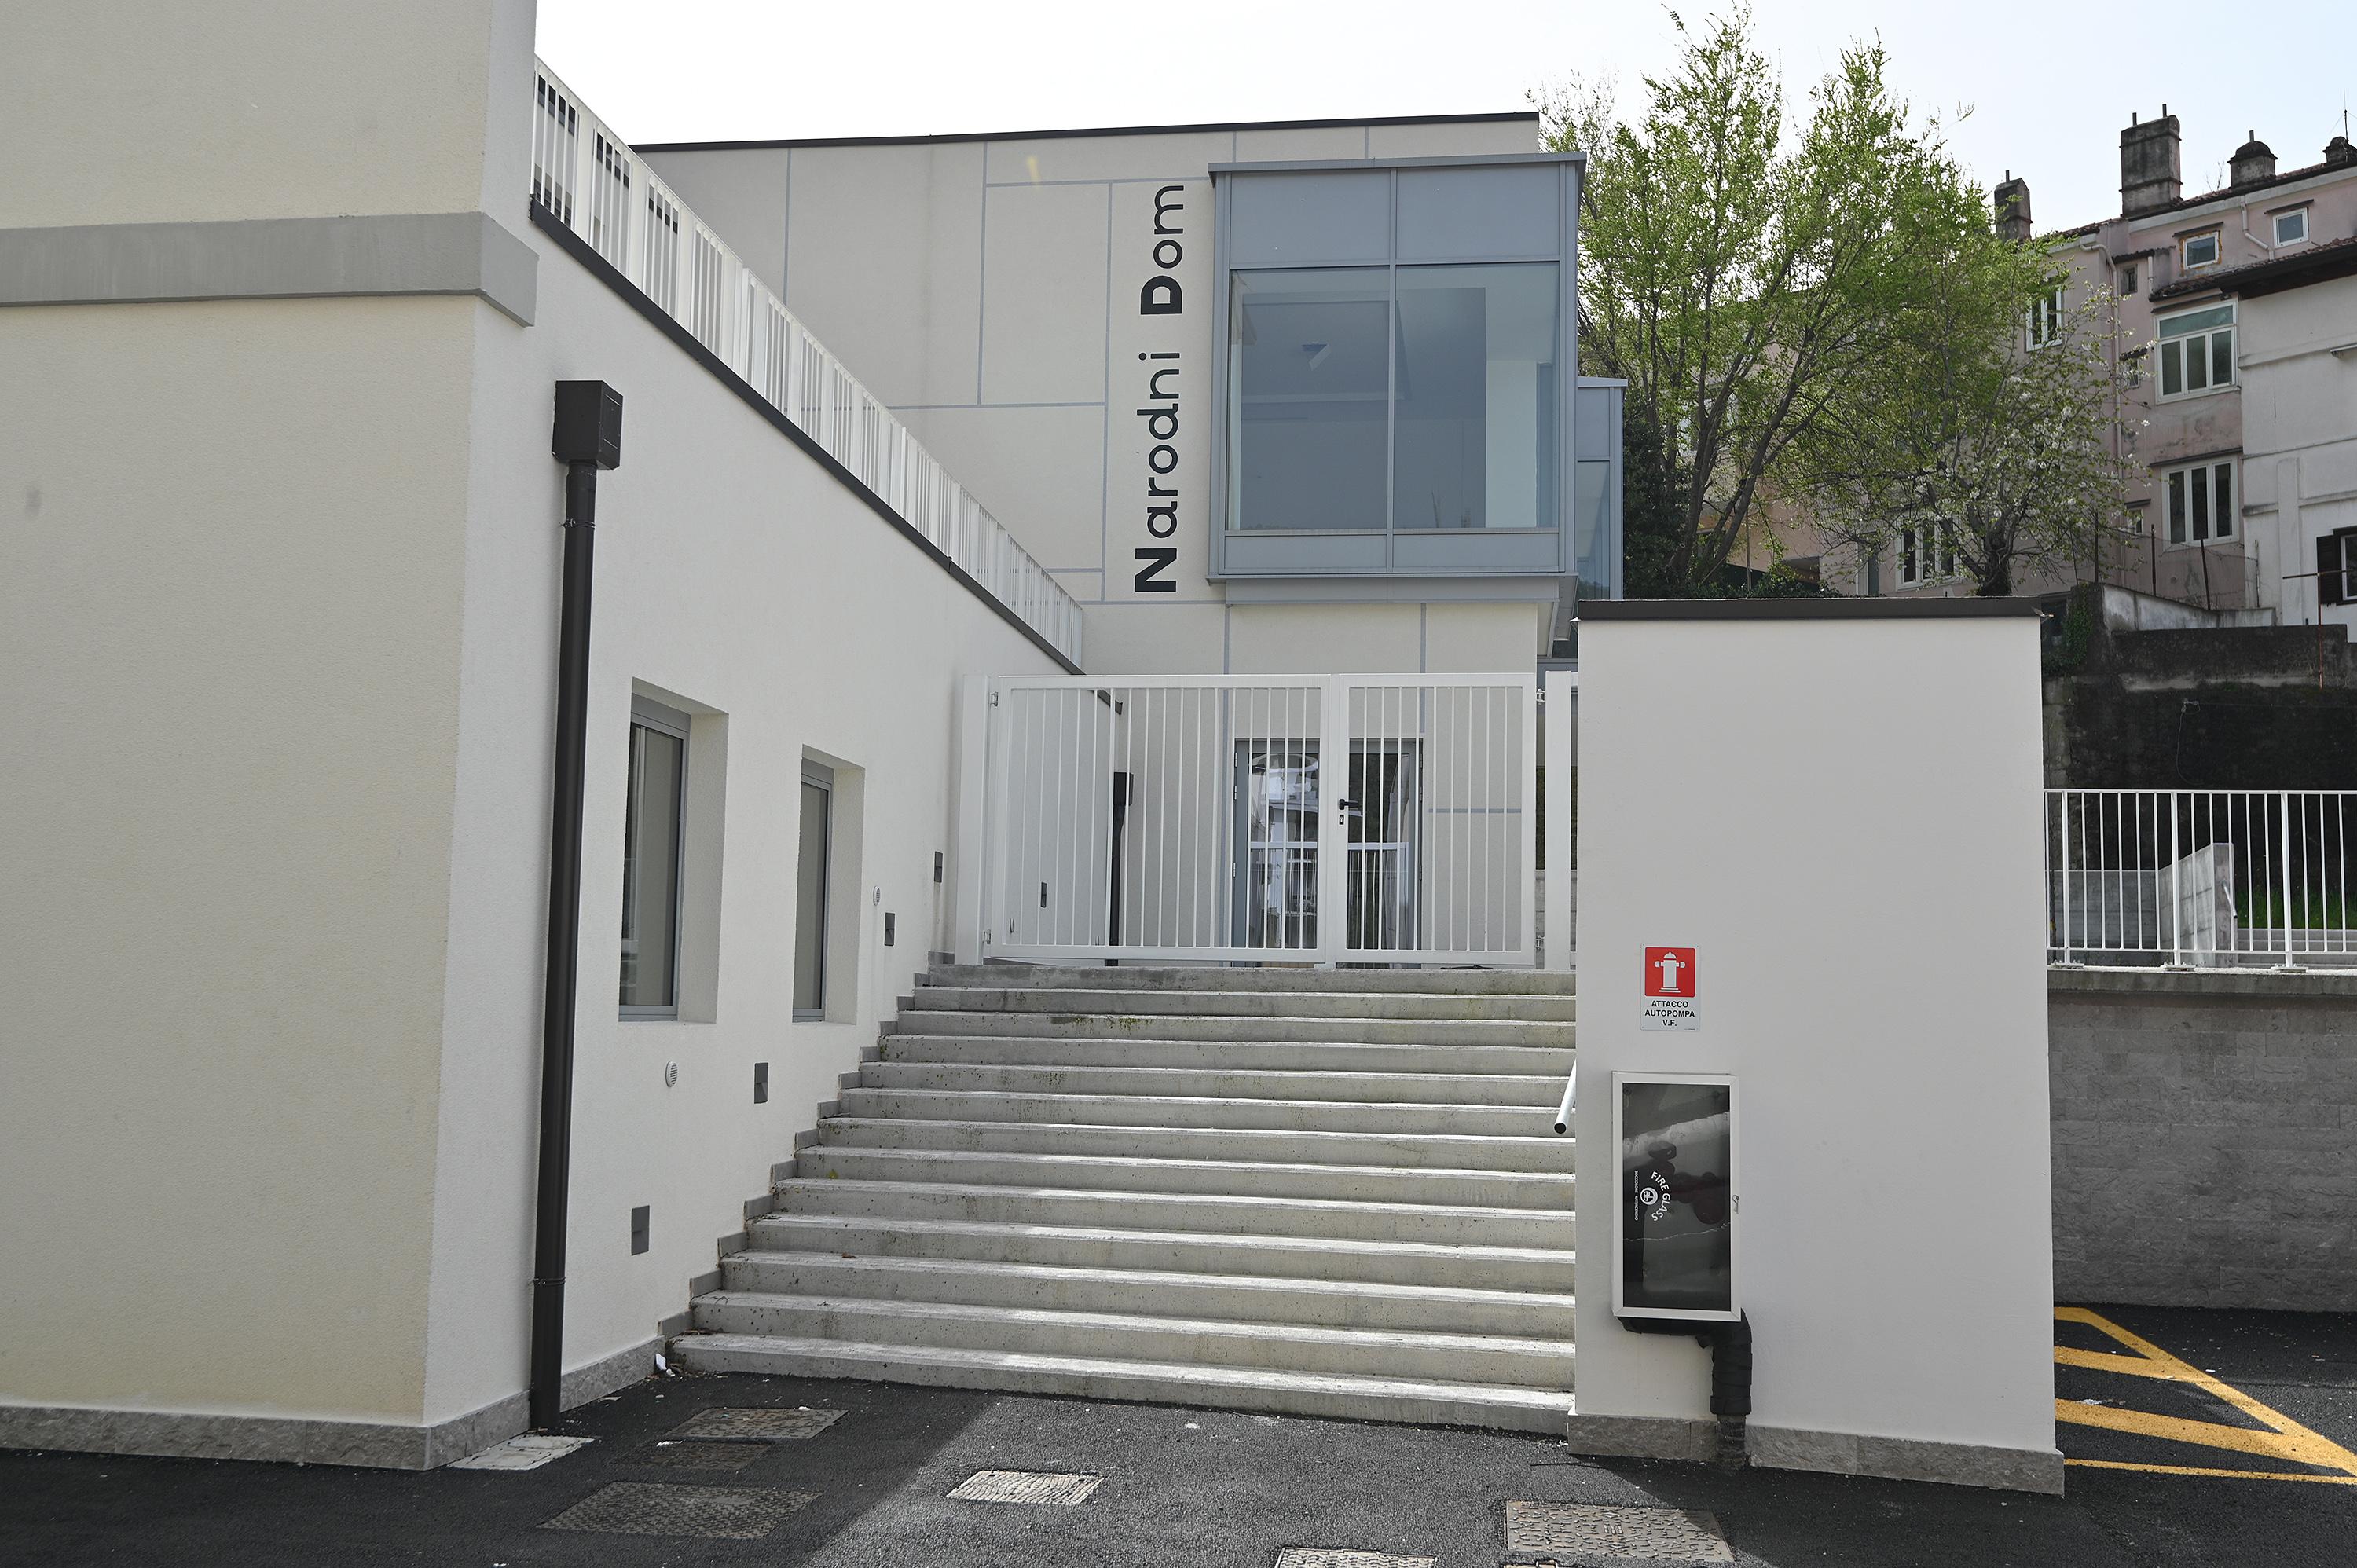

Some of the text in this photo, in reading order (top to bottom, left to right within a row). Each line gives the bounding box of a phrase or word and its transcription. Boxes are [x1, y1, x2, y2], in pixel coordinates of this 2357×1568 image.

[1134, 185, 1185, 592] Narodni Dom
[1651, 1171, 1671, 1221] FIRE GLASS
